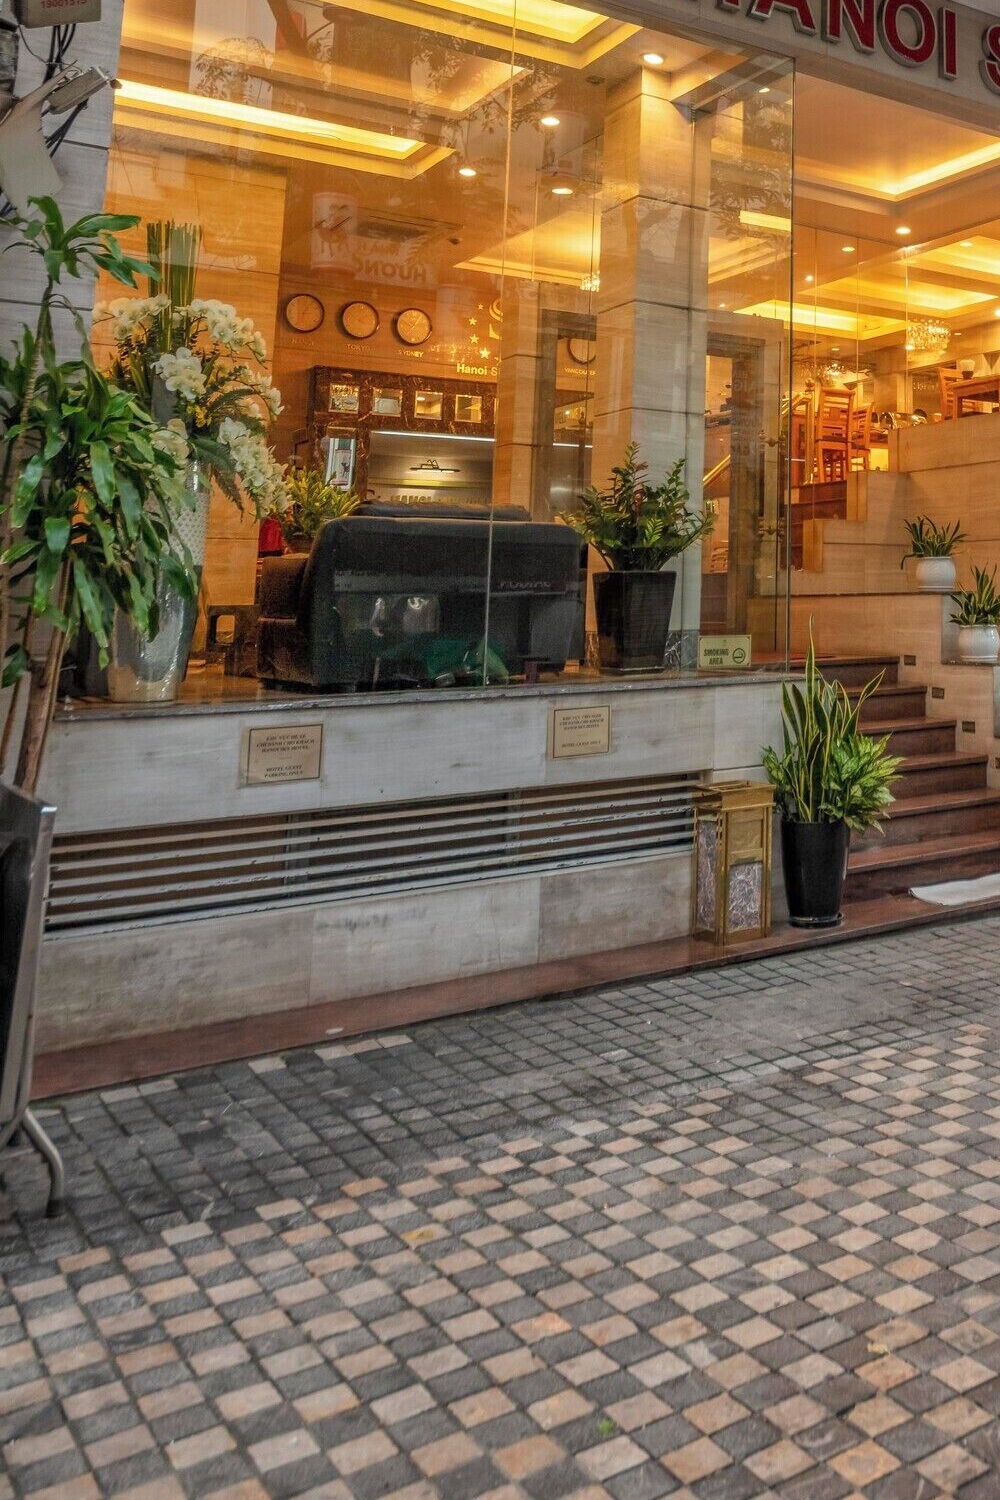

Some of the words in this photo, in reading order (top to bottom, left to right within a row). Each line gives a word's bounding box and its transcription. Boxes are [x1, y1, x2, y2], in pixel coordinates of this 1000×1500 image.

[456, 362, 487, 376] Hanoi
[703, 648, 729, 656] SMOKING
[709, 657, 723, 665] AREA
